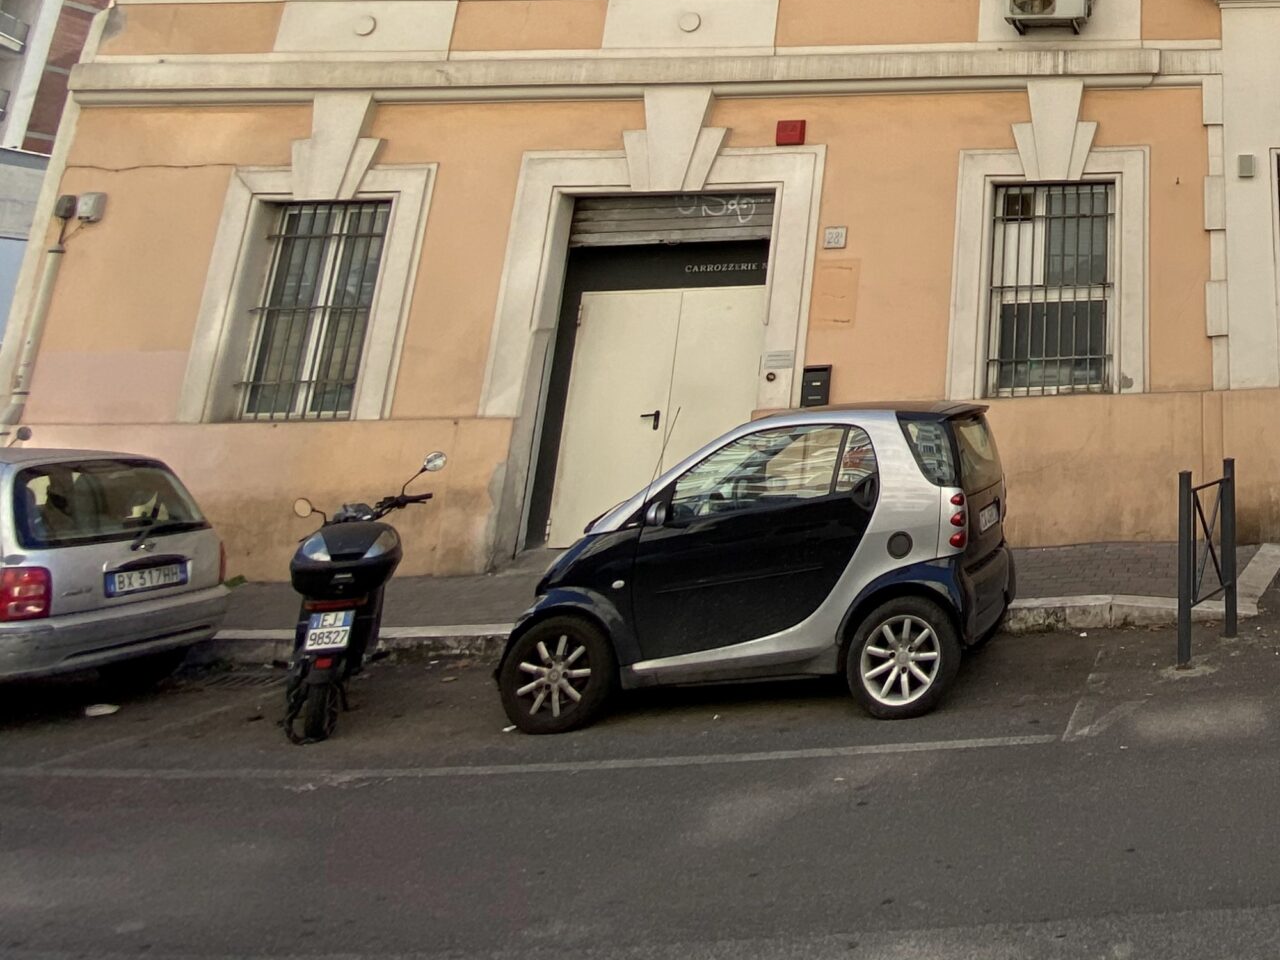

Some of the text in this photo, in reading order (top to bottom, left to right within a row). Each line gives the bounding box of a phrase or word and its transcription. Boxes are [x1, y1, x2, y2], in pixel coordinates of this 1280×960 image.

[685, 262, 758, 273] CARROZZERIE
[320, 613, 339, 627] EJ
[308, 629, 349, 647] 98327
